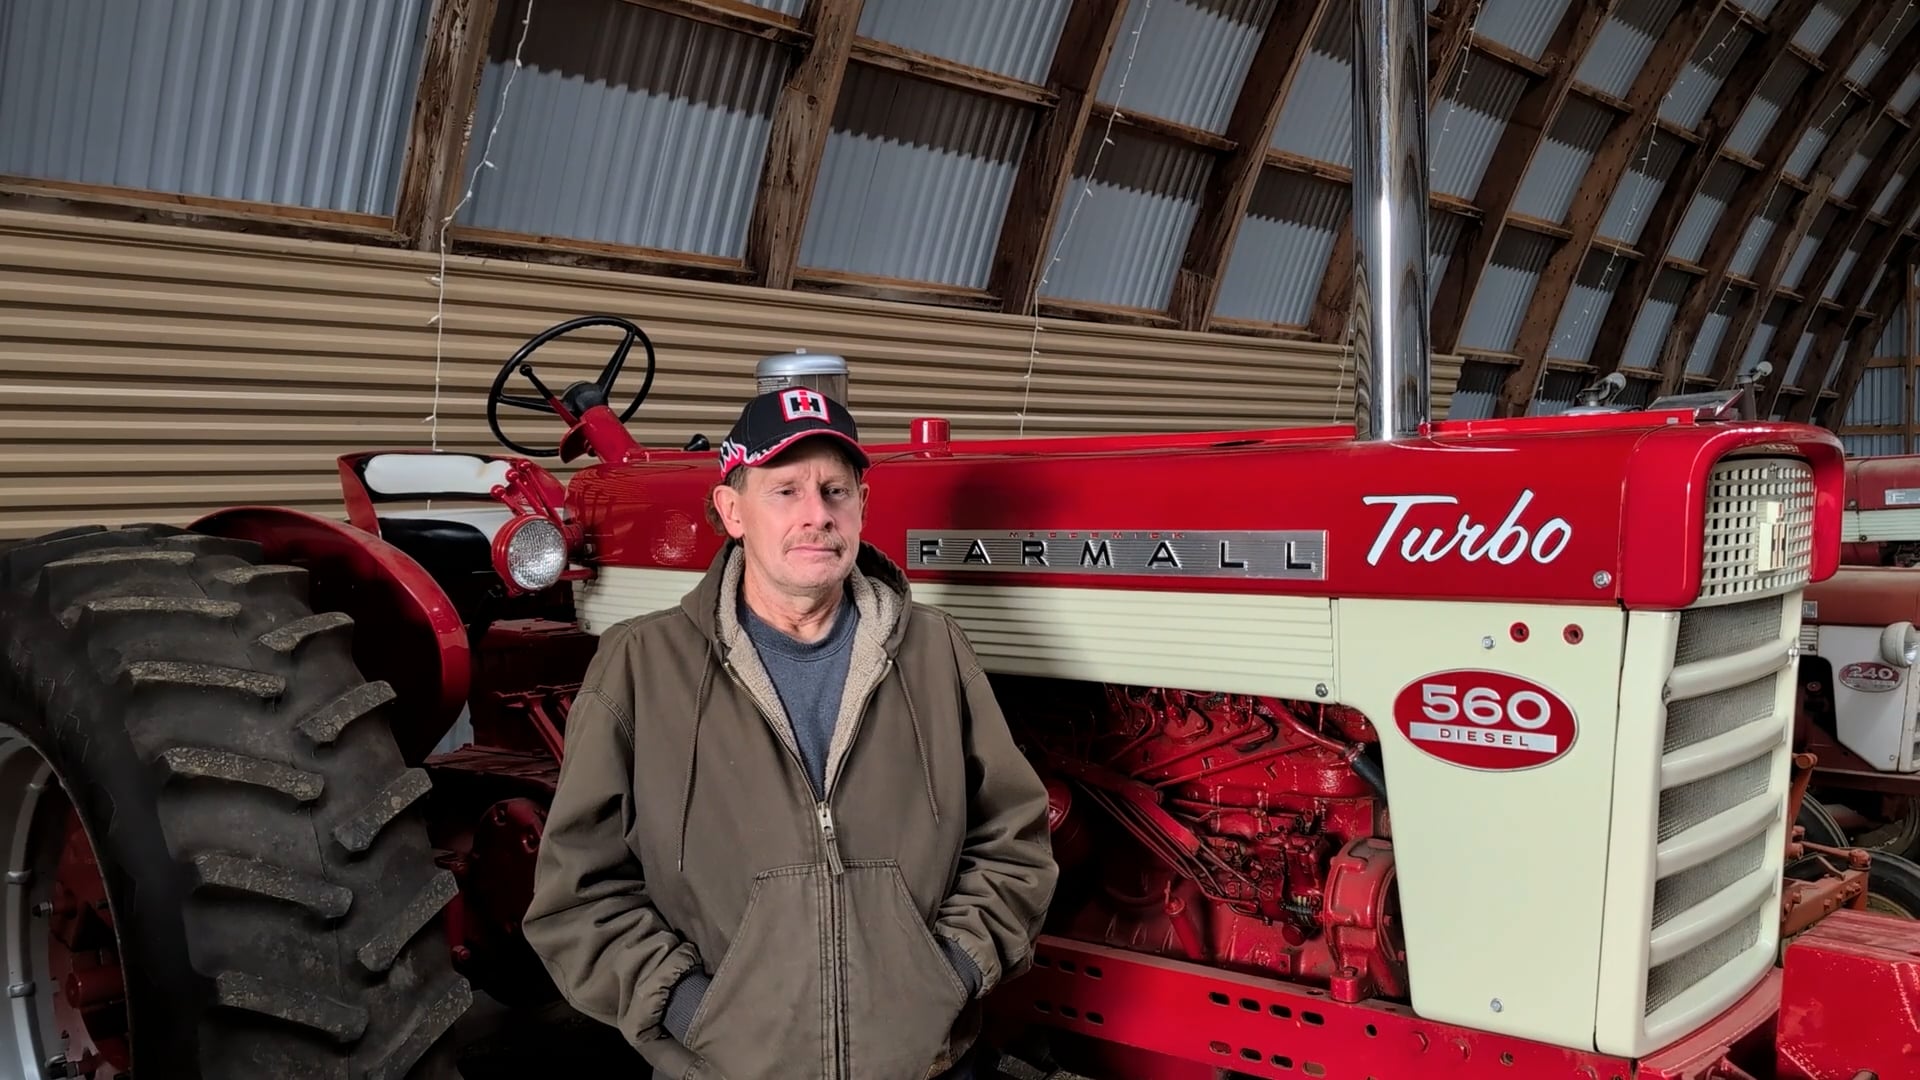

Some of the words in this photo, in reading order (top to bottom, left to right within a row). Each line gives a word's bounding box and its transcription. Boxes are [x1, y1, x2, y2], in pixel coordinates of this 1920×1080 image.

[1362, 488, 1573, 567] Turbo
[918, 539, 1316, 571] FARMALL
[1848, 666, 1894, 680] 240
[1421, 683, 1551, 730] 560
[1440, 728, 1530, 747] DIESEL
